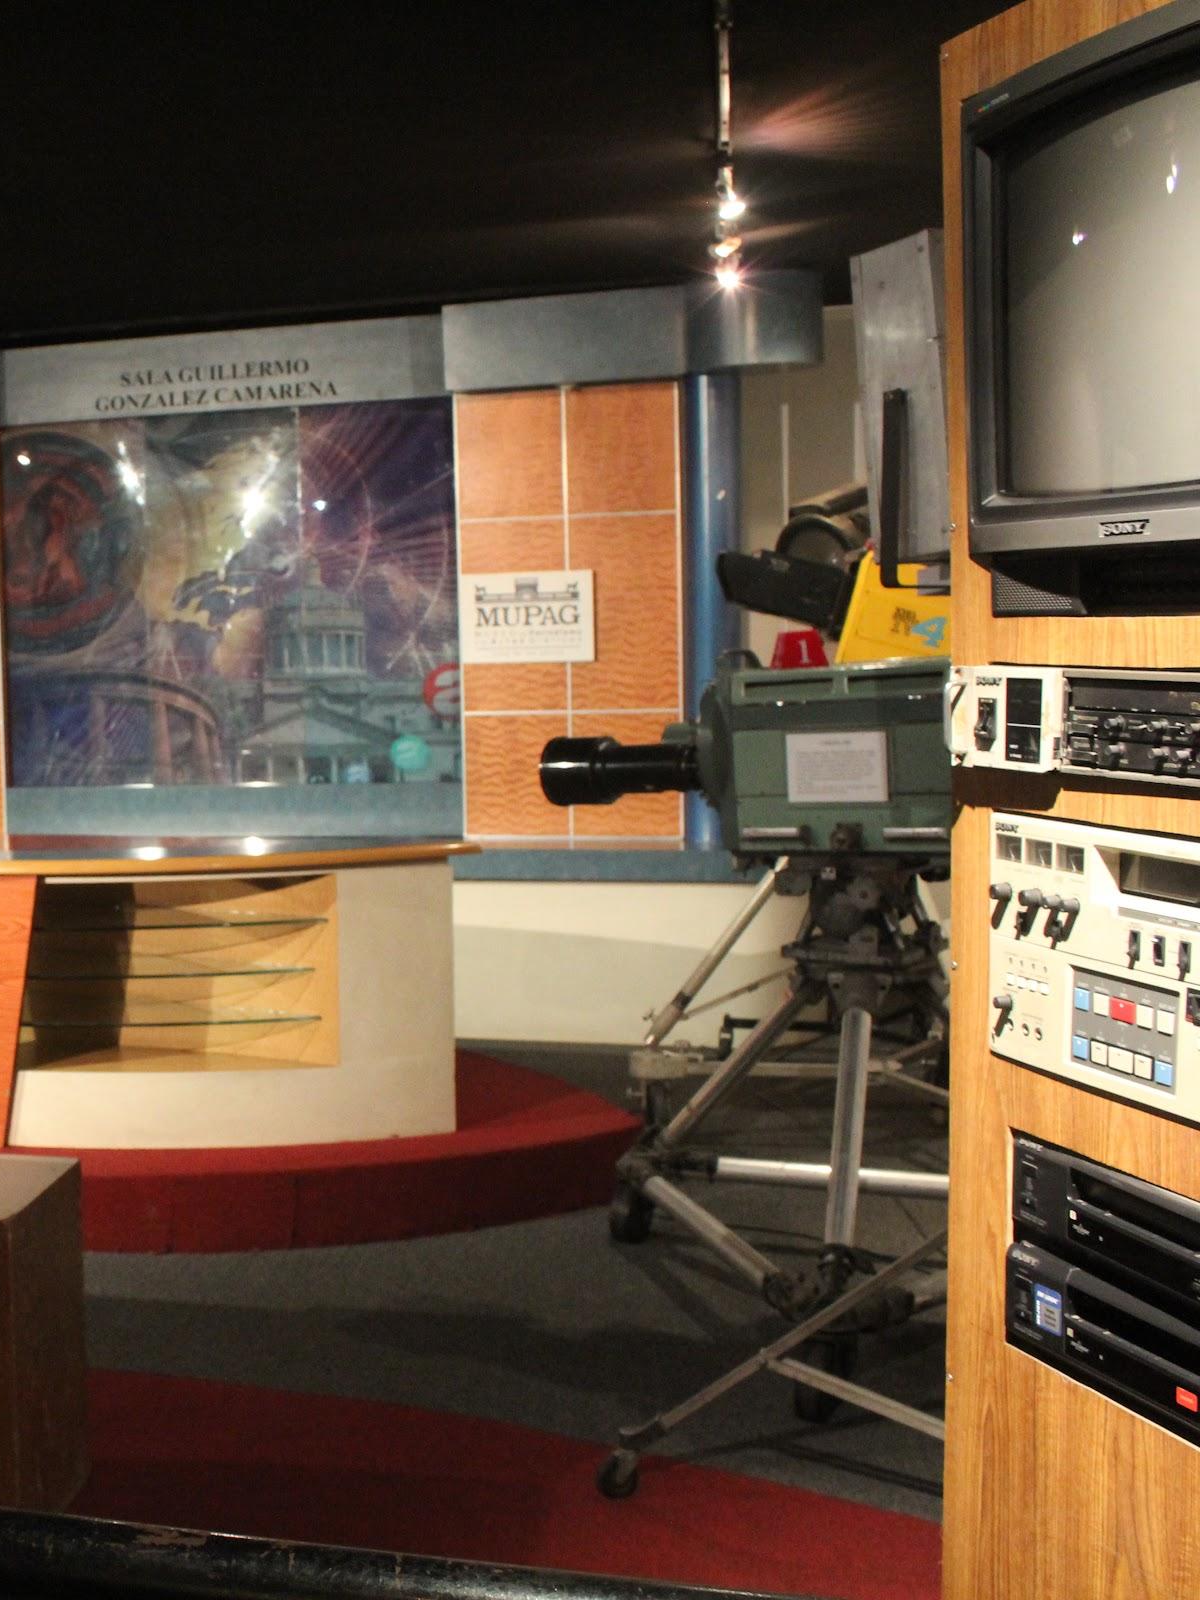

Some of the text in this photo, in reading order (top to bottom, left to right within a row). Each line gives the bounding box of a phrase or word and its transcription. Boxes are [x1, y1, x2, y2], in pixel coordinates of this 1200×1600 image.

[120, 357, 310, 388] SALA GUILLERMO
[95, 380, 339, 413] GONZALEZ CAMARENA
[1102, 519, 1148, 537] SONY
[475, 603, 581, 628] MUPAG
